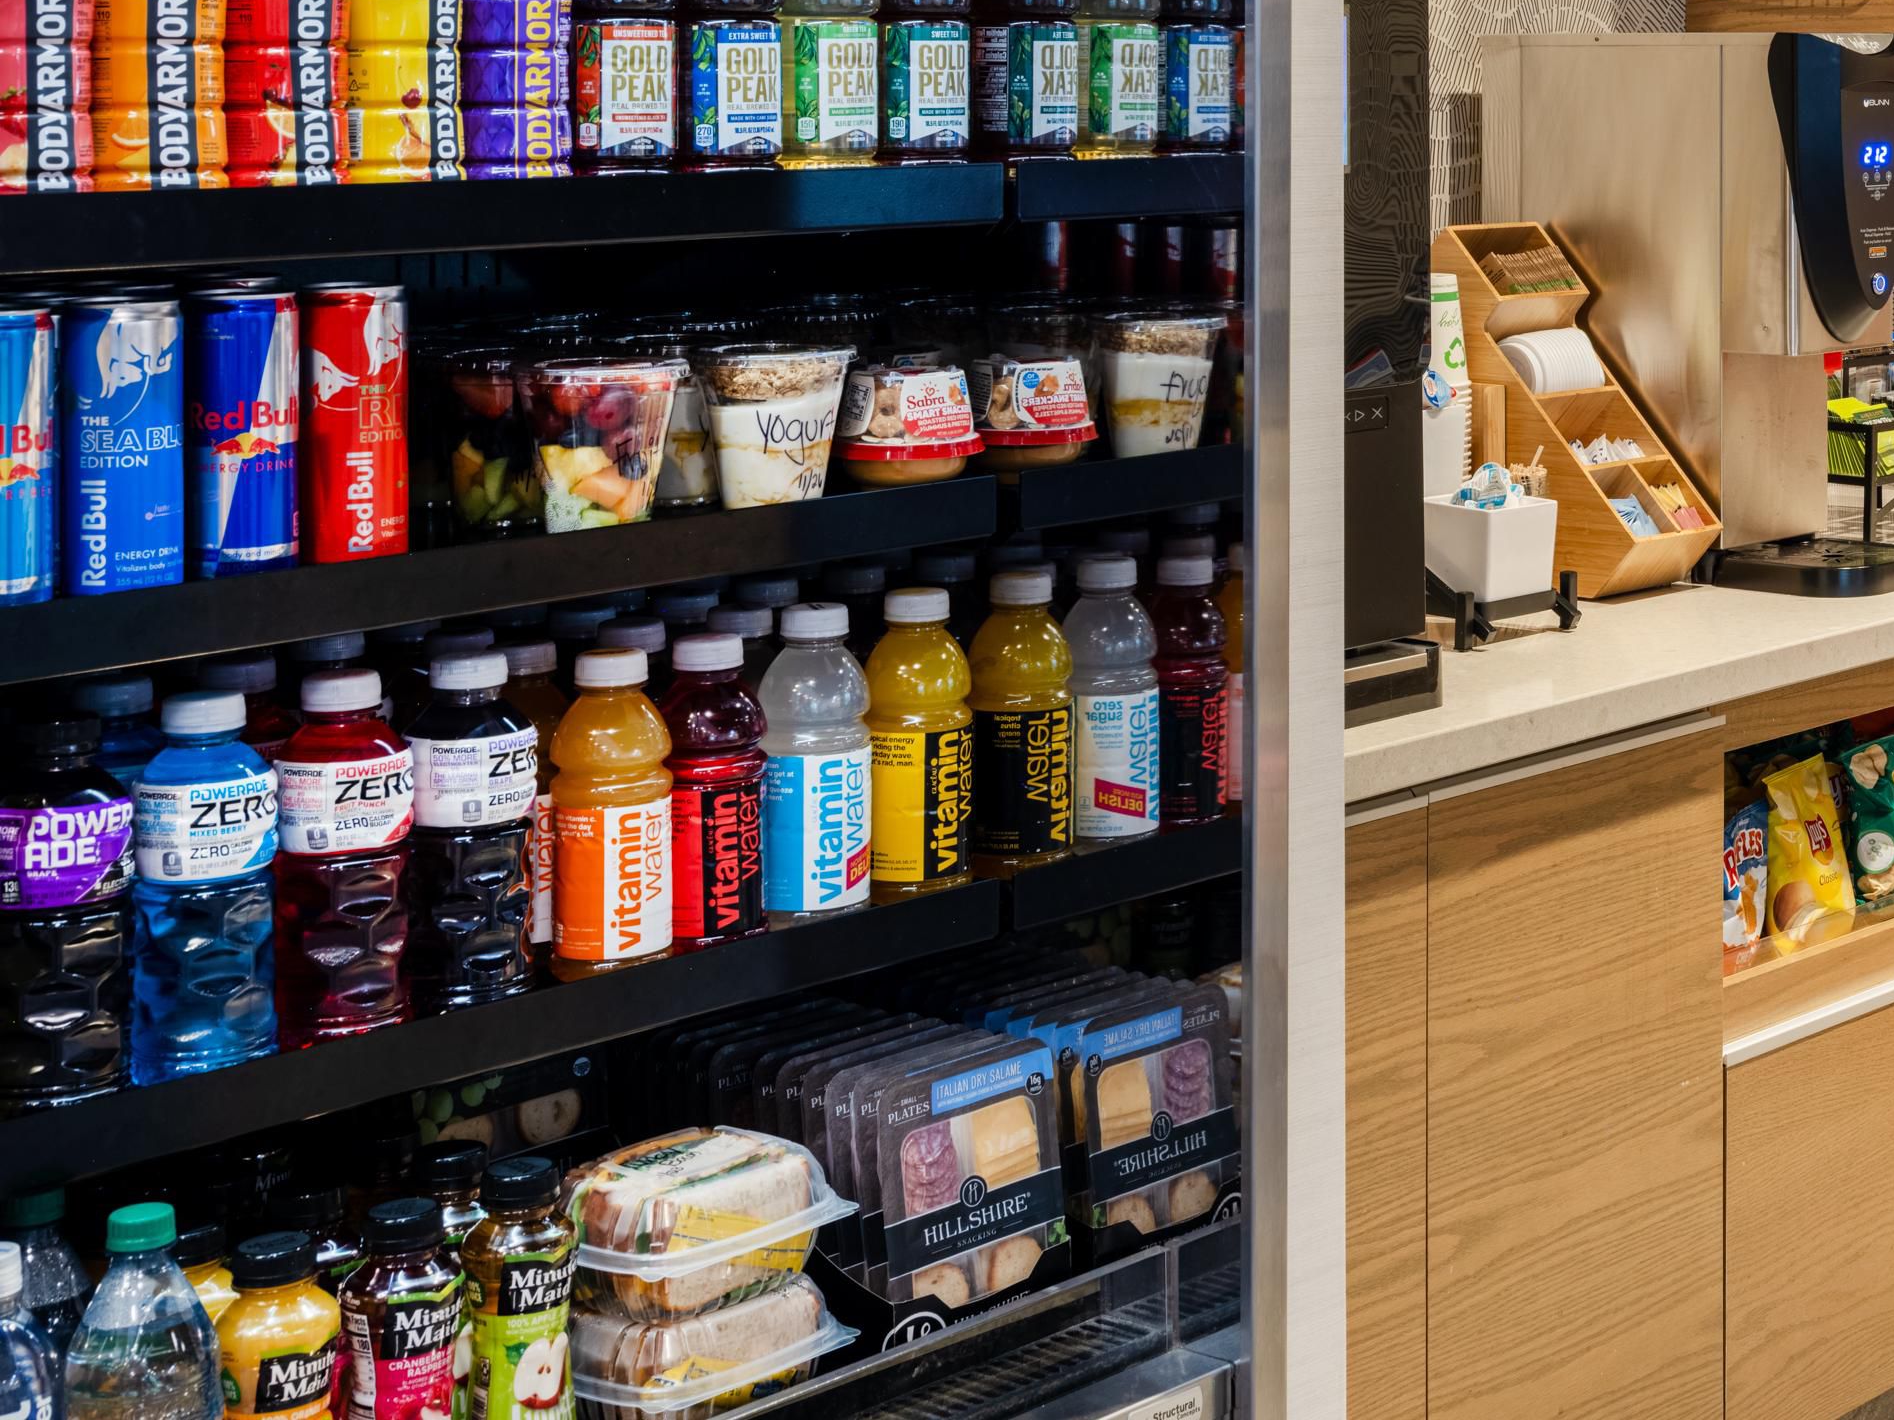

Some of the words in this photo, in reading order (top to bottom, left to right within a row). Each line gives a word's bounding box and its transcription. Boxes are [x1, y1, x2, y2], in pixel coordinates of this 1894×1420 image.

[611, 44, 668, 74] GOLD
[726, 47, 778, 75] GOLD
[827, 43, 874, 70] GOLD
[918, 43, 965, 70] GOLD
[525, 0, 552, 179] BODYARMOR
[611, 75, 668, 102] PEAK
[726, 77, 778, 102] PEAK
[827, 71, 874, 96] PEAK
[918, 71, 965, 97] PEAK
[697, 126, 712, 136] 270
[1863, 146, 1888, 164] 212
[359, 385, 386, 395] THE
[907, 395, 945, 409] Sabra
[81, 416, 109, 427] THE
[80, 429, 142, 452] SEA
[80, 455, 148, 469] EDITION
[347, 451, 374, 500] Bull
[81, 480, 107, 527] Bull
[347, 504, 374, 553] Red
[81, 529, 107, 586] Red
[115, 550, 156, 561] ENERGY
[335, 757, 408, 779] POWERADE
[190, 780, 268, 801] POWERADE
[489, 791, 519, 806] ZERO
[930, 732, 958, 872] vitamin
[27, 802, 133, 842] POWER
[190, 790, 276, 828] ZERO
[335, 817, 368, 831] ZERO
[811, 759, 843, 904] vitamin
[846, 758, 864, 853] water
[25, 837, 97, 870] ADE
[190, 845, 230, 860] ZERO
[708, 793, 740, 929] vitamin
[739, 792, 758, 881] water
[610, 812, 642, 952] vitamin
[644, 811, 663, 903] water
[936, 1082, 969, 1099] ITALIAN
[990, 1061, 1022, 1082] SALAME
[1029, 1075, 1041, 1086] 16g
[888, 1101, 930, 1125] PLATES
[924, 1193, 1029, 1246] HILLSHIRE
[520, 1284, 571, 1308] Maid
[269, 1351, 335, 1387] Minute
[282, 1377, 329, 1404] Maid
